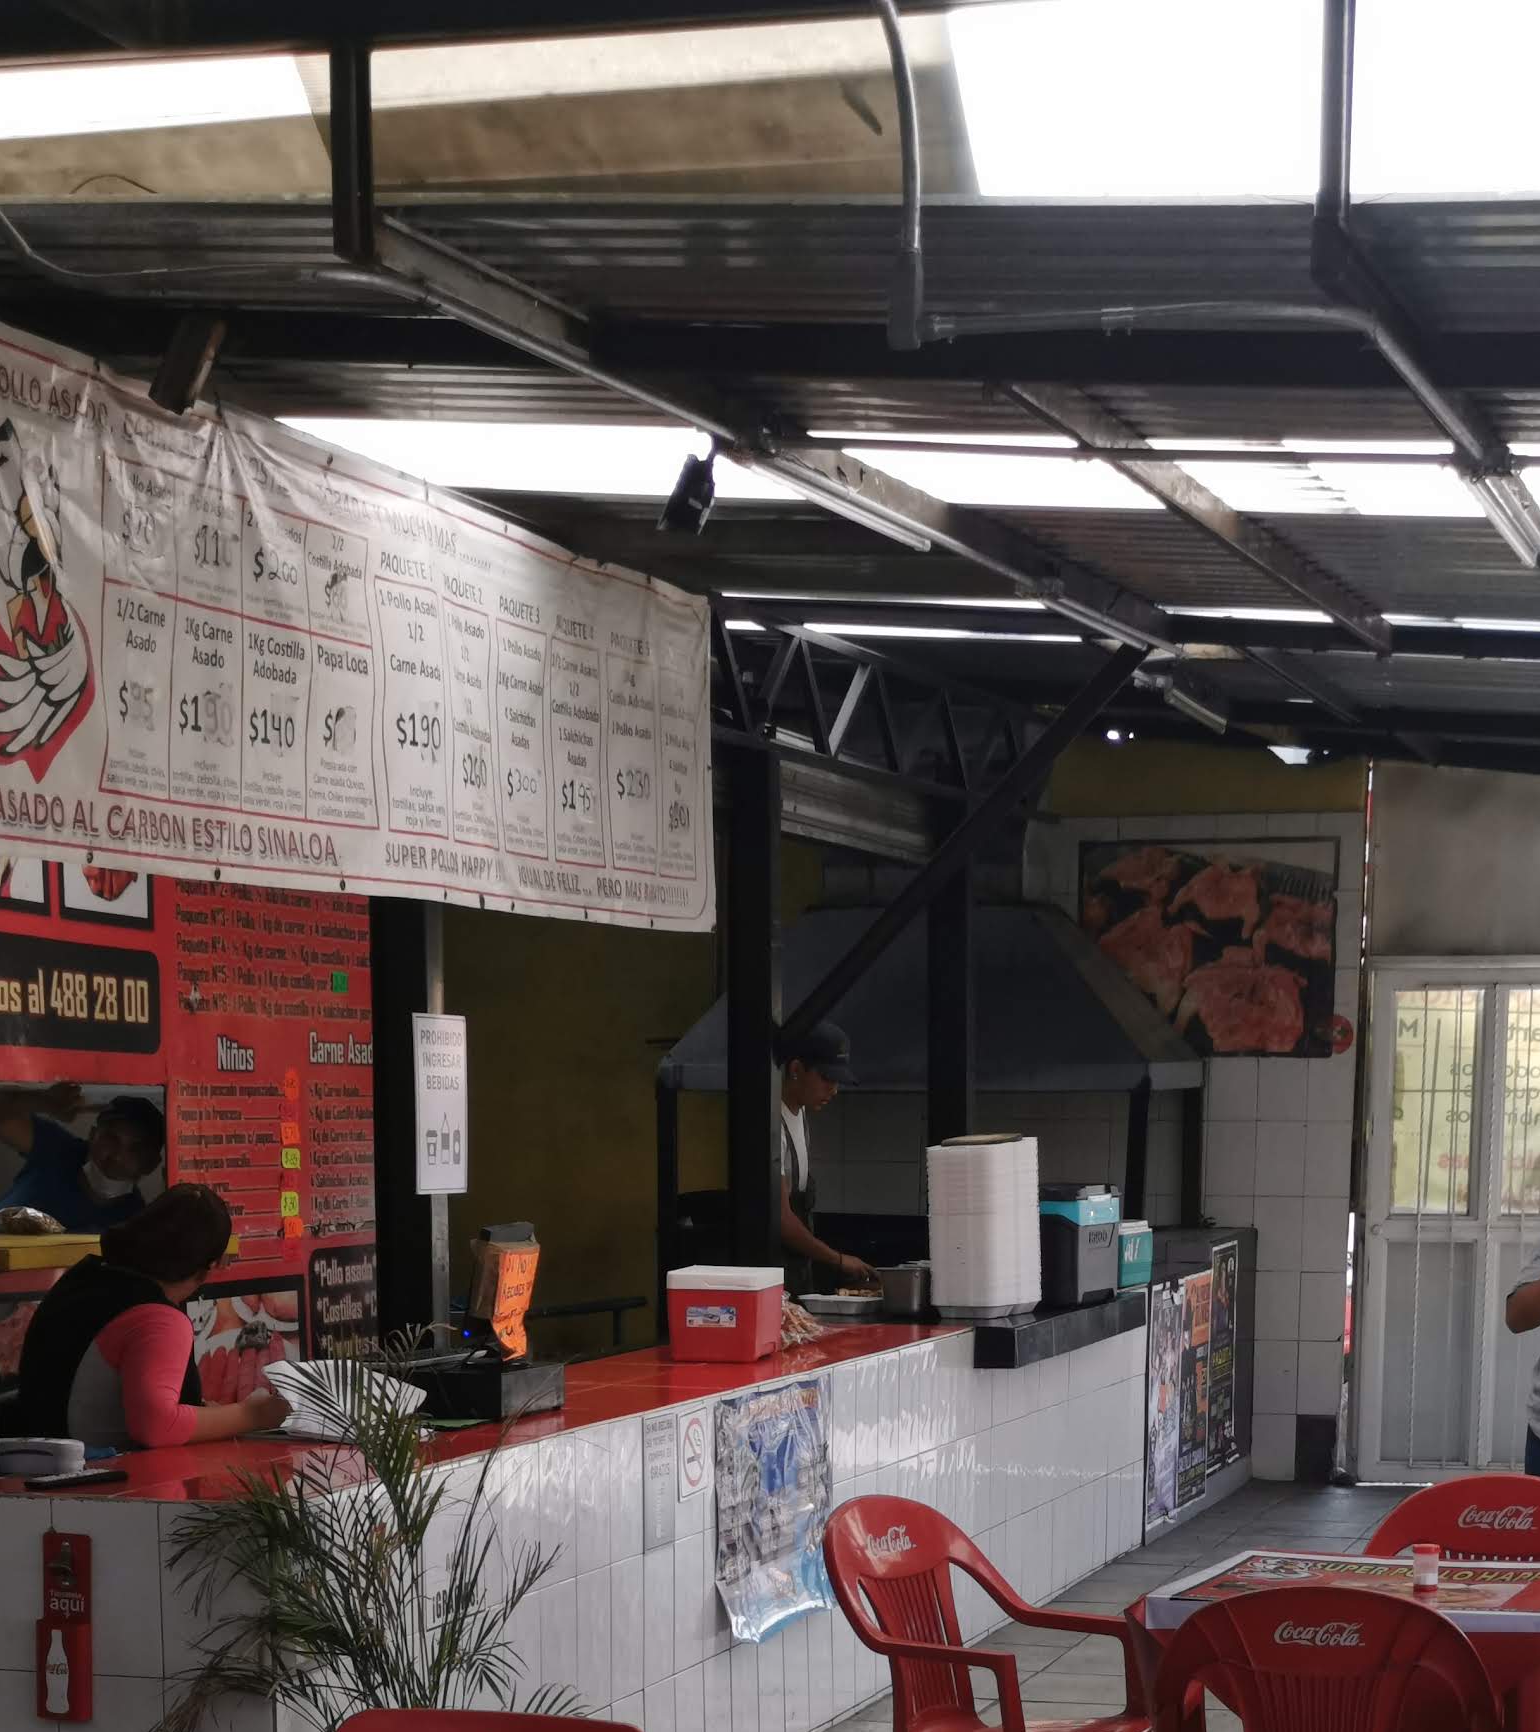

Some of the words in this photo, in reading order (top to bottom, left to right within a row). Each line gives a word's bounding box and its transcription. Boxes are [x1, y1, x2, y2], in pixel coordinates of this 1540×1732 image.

[380, 552, 425, 581] PAQUETE
[117, 599, 135, 621] 1/2
[137, 604, 166, 628] Carne
[387, 590, 412, 612] Pollo
[499, 595, 532, 623] PAQUETE
[125, 630, 157, 653] Asado
[185, 616, 201, 641] 1Kg
[202, 620, 233, 644] Carne
[192, 647, 225, 670] Asado
[266, 636, 306, 662] Costilla
[317, 645, 345, 673] Papa
[346, 648, 369, 676] Loca
[253, 662, 297, 686] Adobada
[391, 654, 417, 679] Carne
[396, 713, 442, 751] $190
[73, 800, 100, 836] AL
[107, 805, 186, 848] CARBON
[192, 817, 252, 855] ESTILO
[258, 826, 339, 866] SINALOA
[385, 843, 427, 870] SUPER
[28, 963, 47, 1015] al
[49, 967, 88, 1019] 488
[93, 974, 119, 1022] 28
[123, 976, 150, 1025] 00
[217, 1033, 254, 1073] Niños
[309, 1030, 344, 1067] Carne
[421, 1030, 463, 1048] PROHIBIDO
[422, 1051, 462, 1069] INGRESAR
[426, 1074, 460, 1091] BEBIDAS
[1458, 1504, 1537, 1531] Coca-Cola
[865, 1524, 916, 1557] Coca-Cola
[1314, 1560, 1391, 1578] SUPER
[1393, 1564, 1479, 1583] POLO
[1273, 1620, 1366, 1648] Coca-Cola
